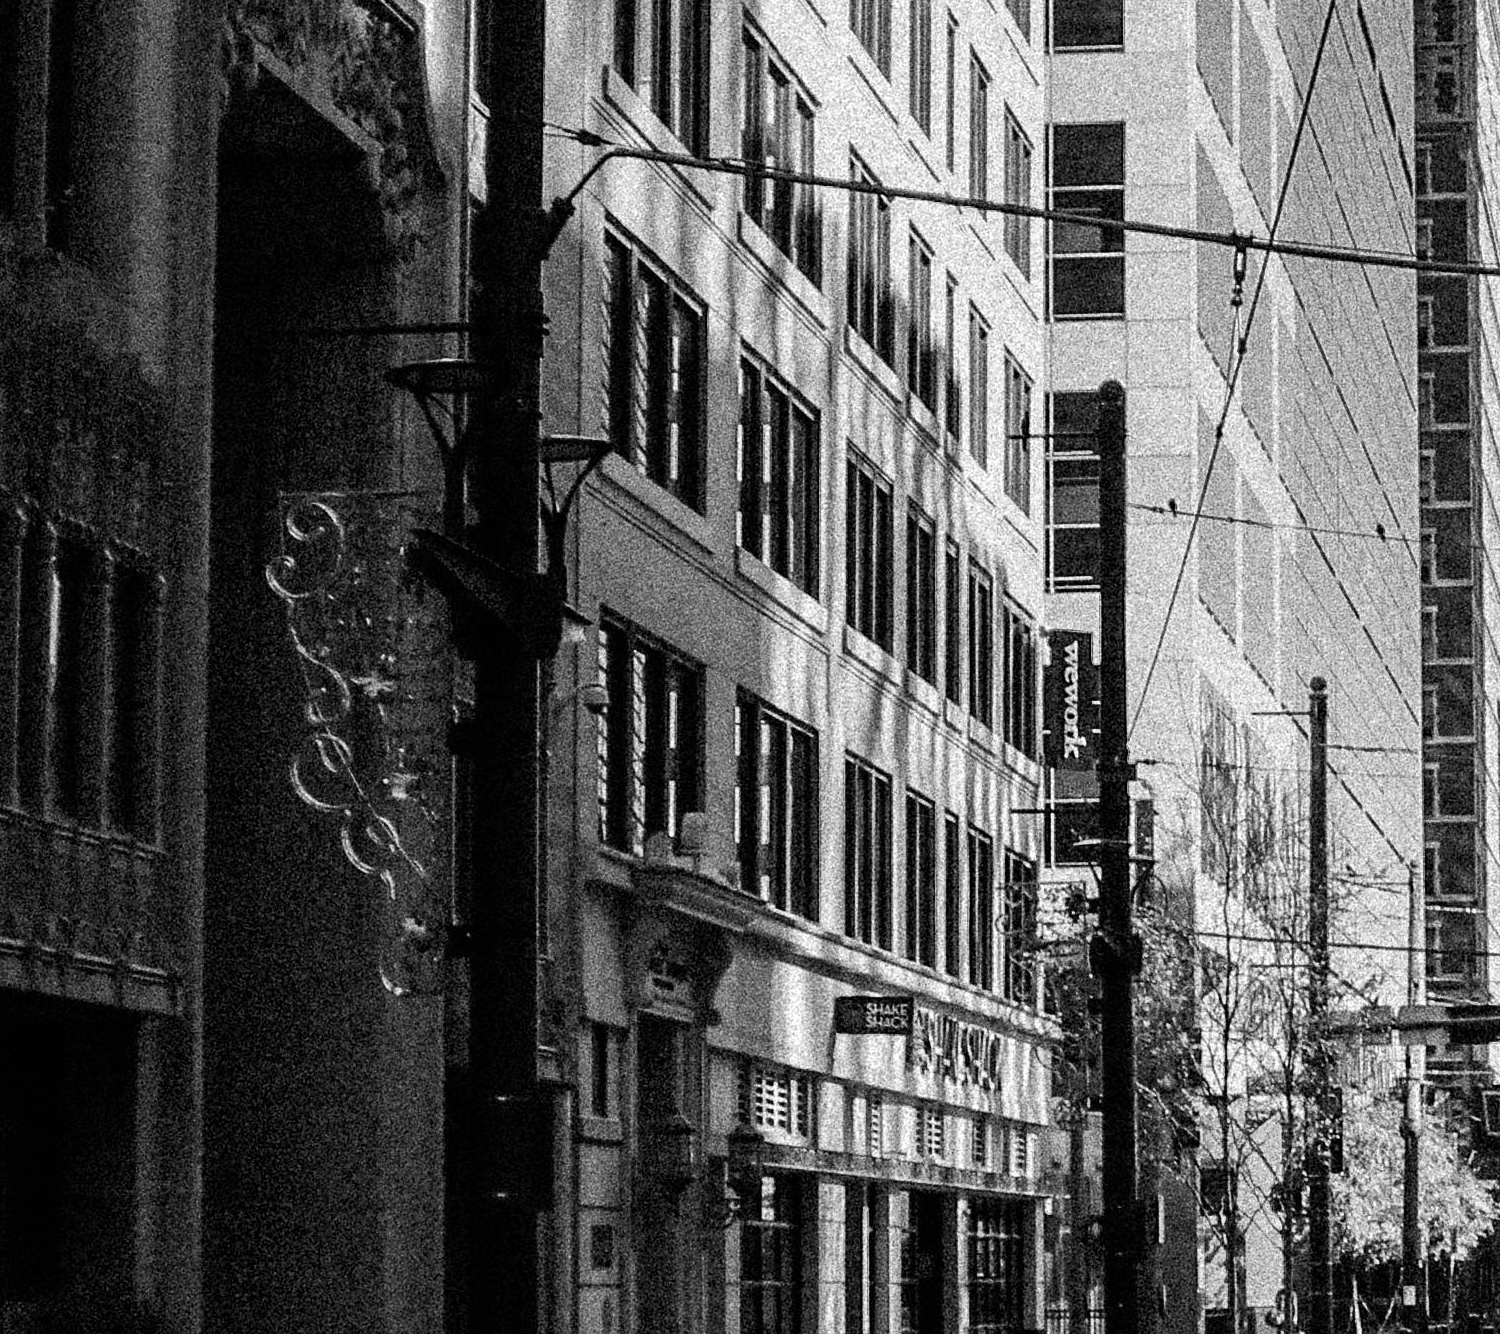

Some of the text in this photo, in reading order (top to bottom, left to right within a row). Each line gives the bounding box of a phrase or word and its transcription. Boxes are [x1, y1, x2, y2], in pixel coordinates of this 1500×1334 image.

[1063, 640, 1087, 759] wework
[866, 1002, 910, 1016] SHAKE
[865, 1014, 910, 1029] SHACK
